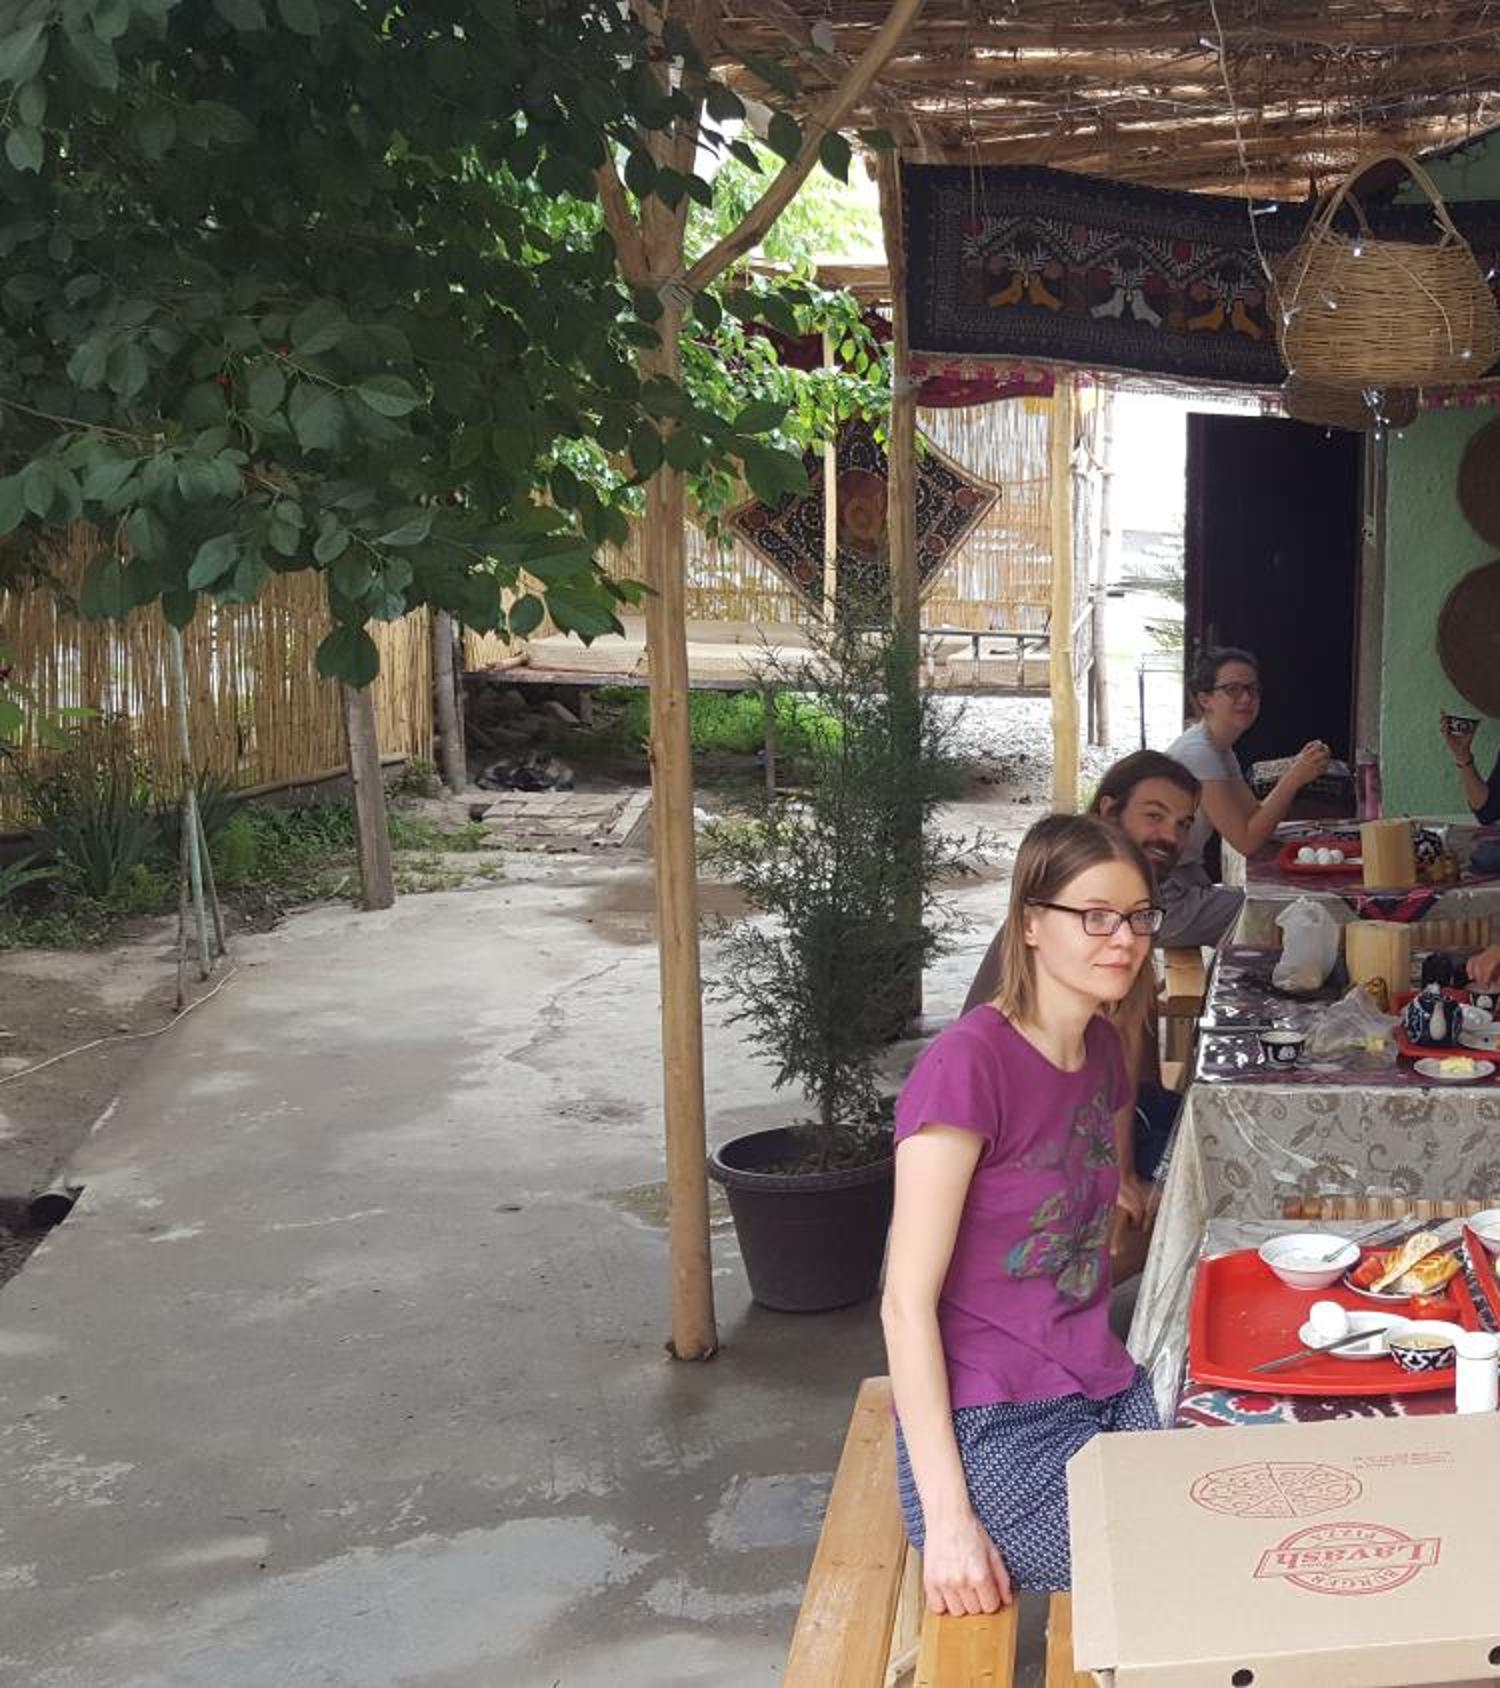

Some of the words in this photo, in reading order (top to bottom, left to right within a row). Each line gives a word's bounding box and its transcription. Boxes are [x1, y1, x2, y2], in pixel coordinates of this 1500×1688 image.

[1310, 1529, 1377, 1541] PIZZA
[1276, 1544, 1425, 1569] Lavash
[1310, 1570, 1398, 1587] BURGER
